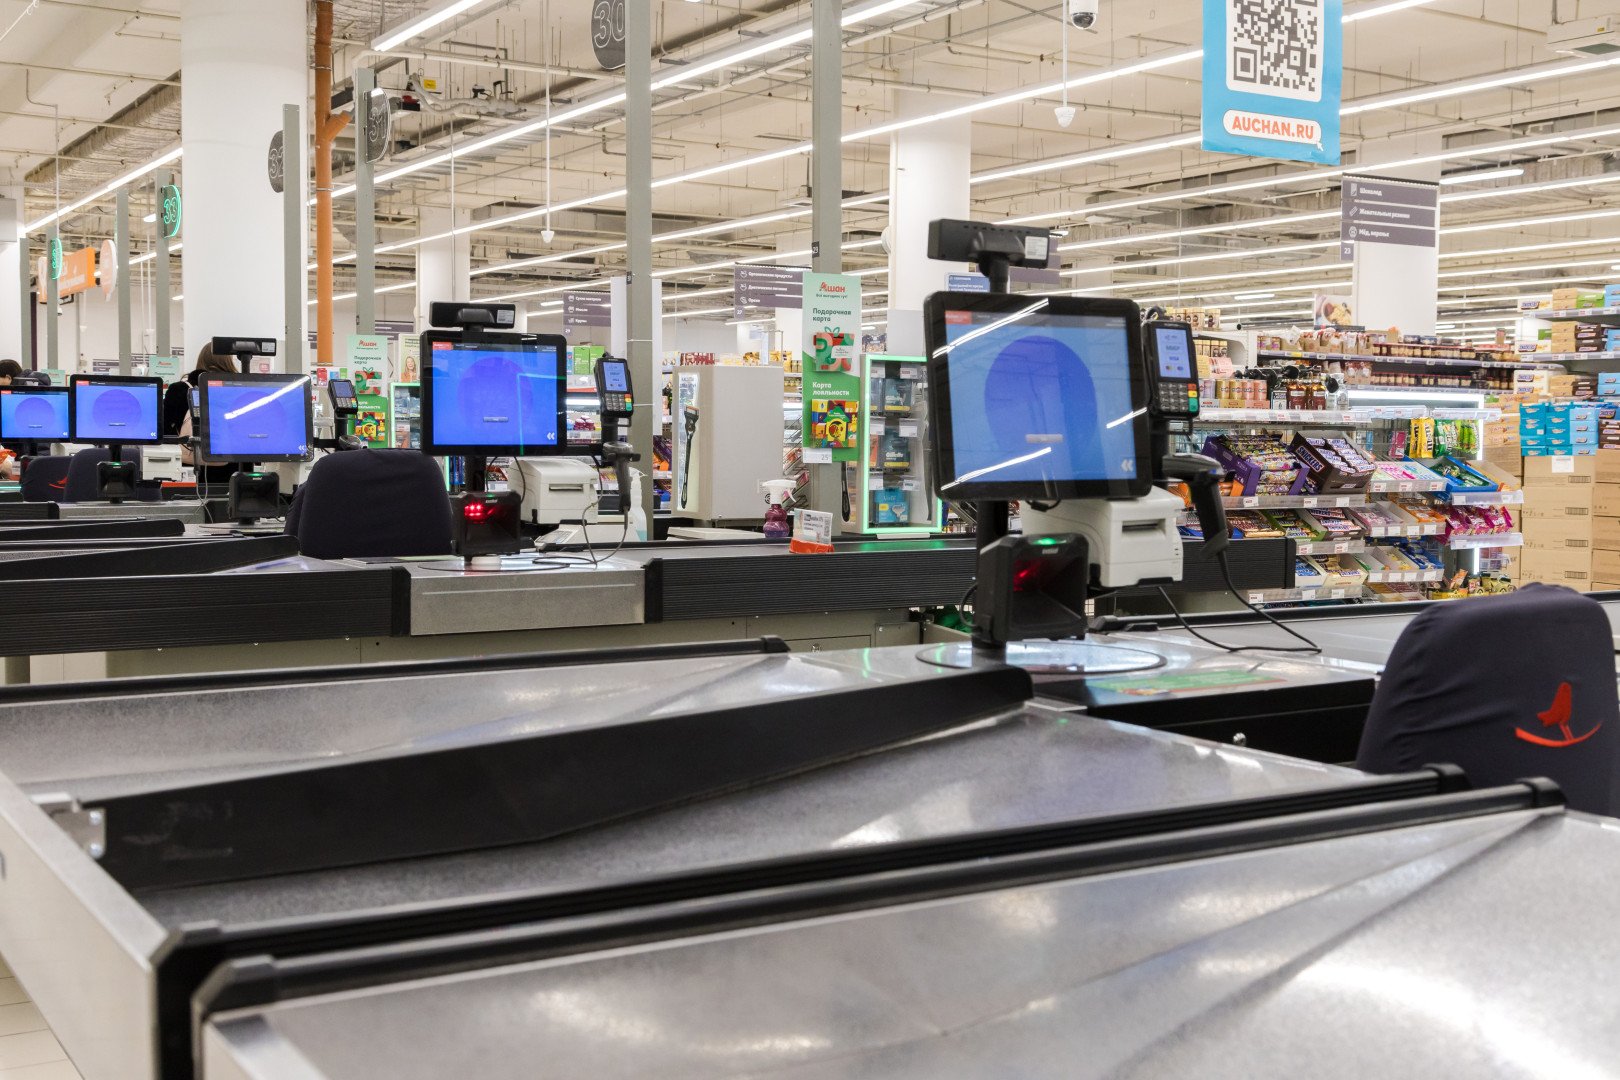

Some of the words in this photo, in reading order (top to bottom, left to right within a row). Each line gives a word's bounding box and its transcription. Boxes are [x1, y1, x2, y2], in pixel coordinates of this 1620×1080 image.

[594, 0, 625, 48] 30
[1232, 116, 1314, 140] AUCHAN.RU
[163, 197, 177, 224] 33
[812, 308, 852, 316] Подарочная
[812, 381, 832, 389] Карта
[1298, 445, 1323, 472] SNICKERS
